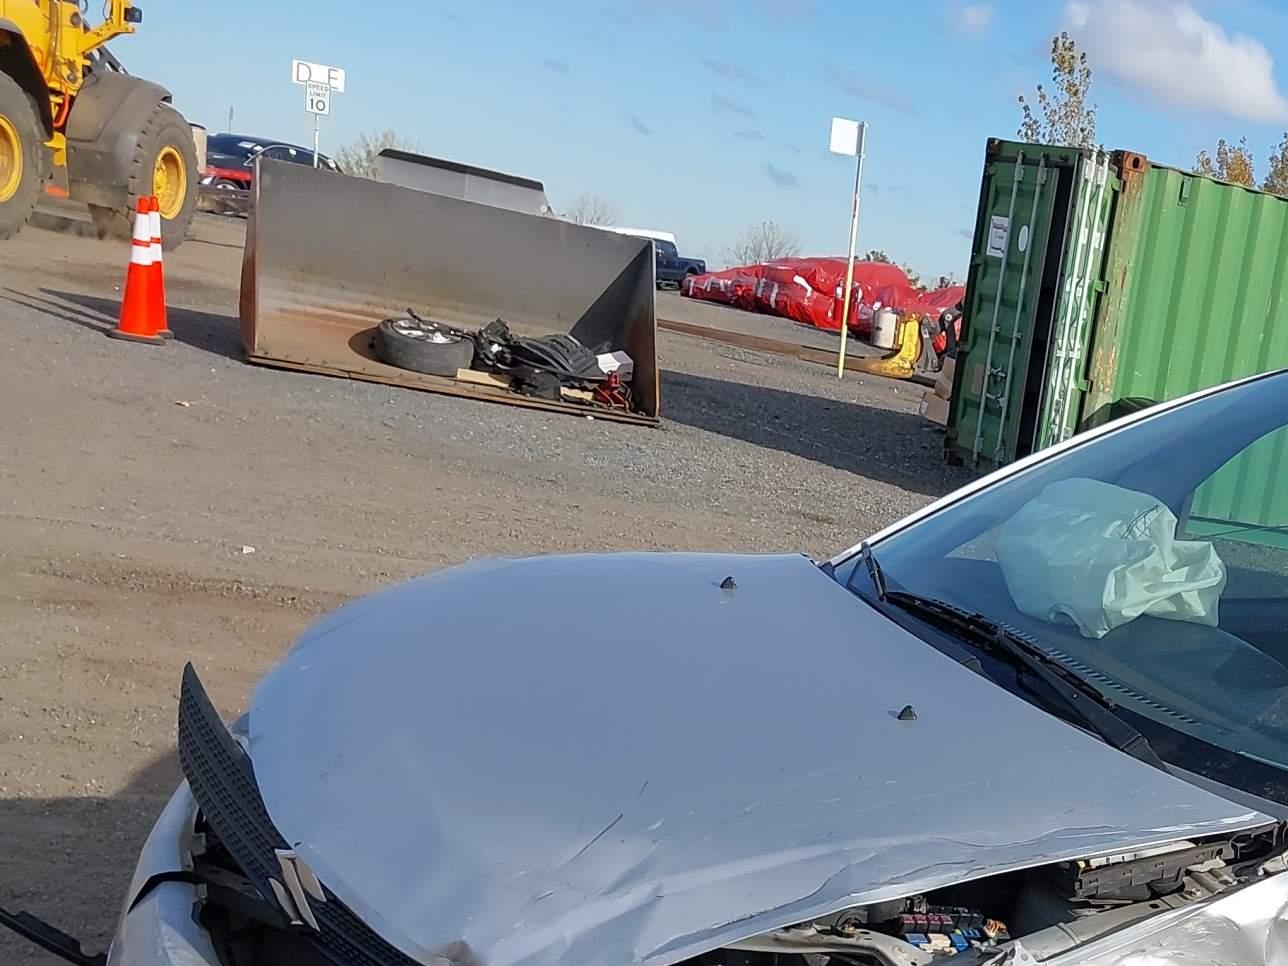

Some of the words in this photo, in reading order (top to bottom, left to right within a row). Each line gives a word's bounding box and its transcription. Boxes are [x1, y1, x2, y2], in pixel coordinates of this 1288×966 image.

[308, 83, 329, 92] SPEED
[309, 90, 326, 98] LIMIT
[309, 98, 326, 111] 10
